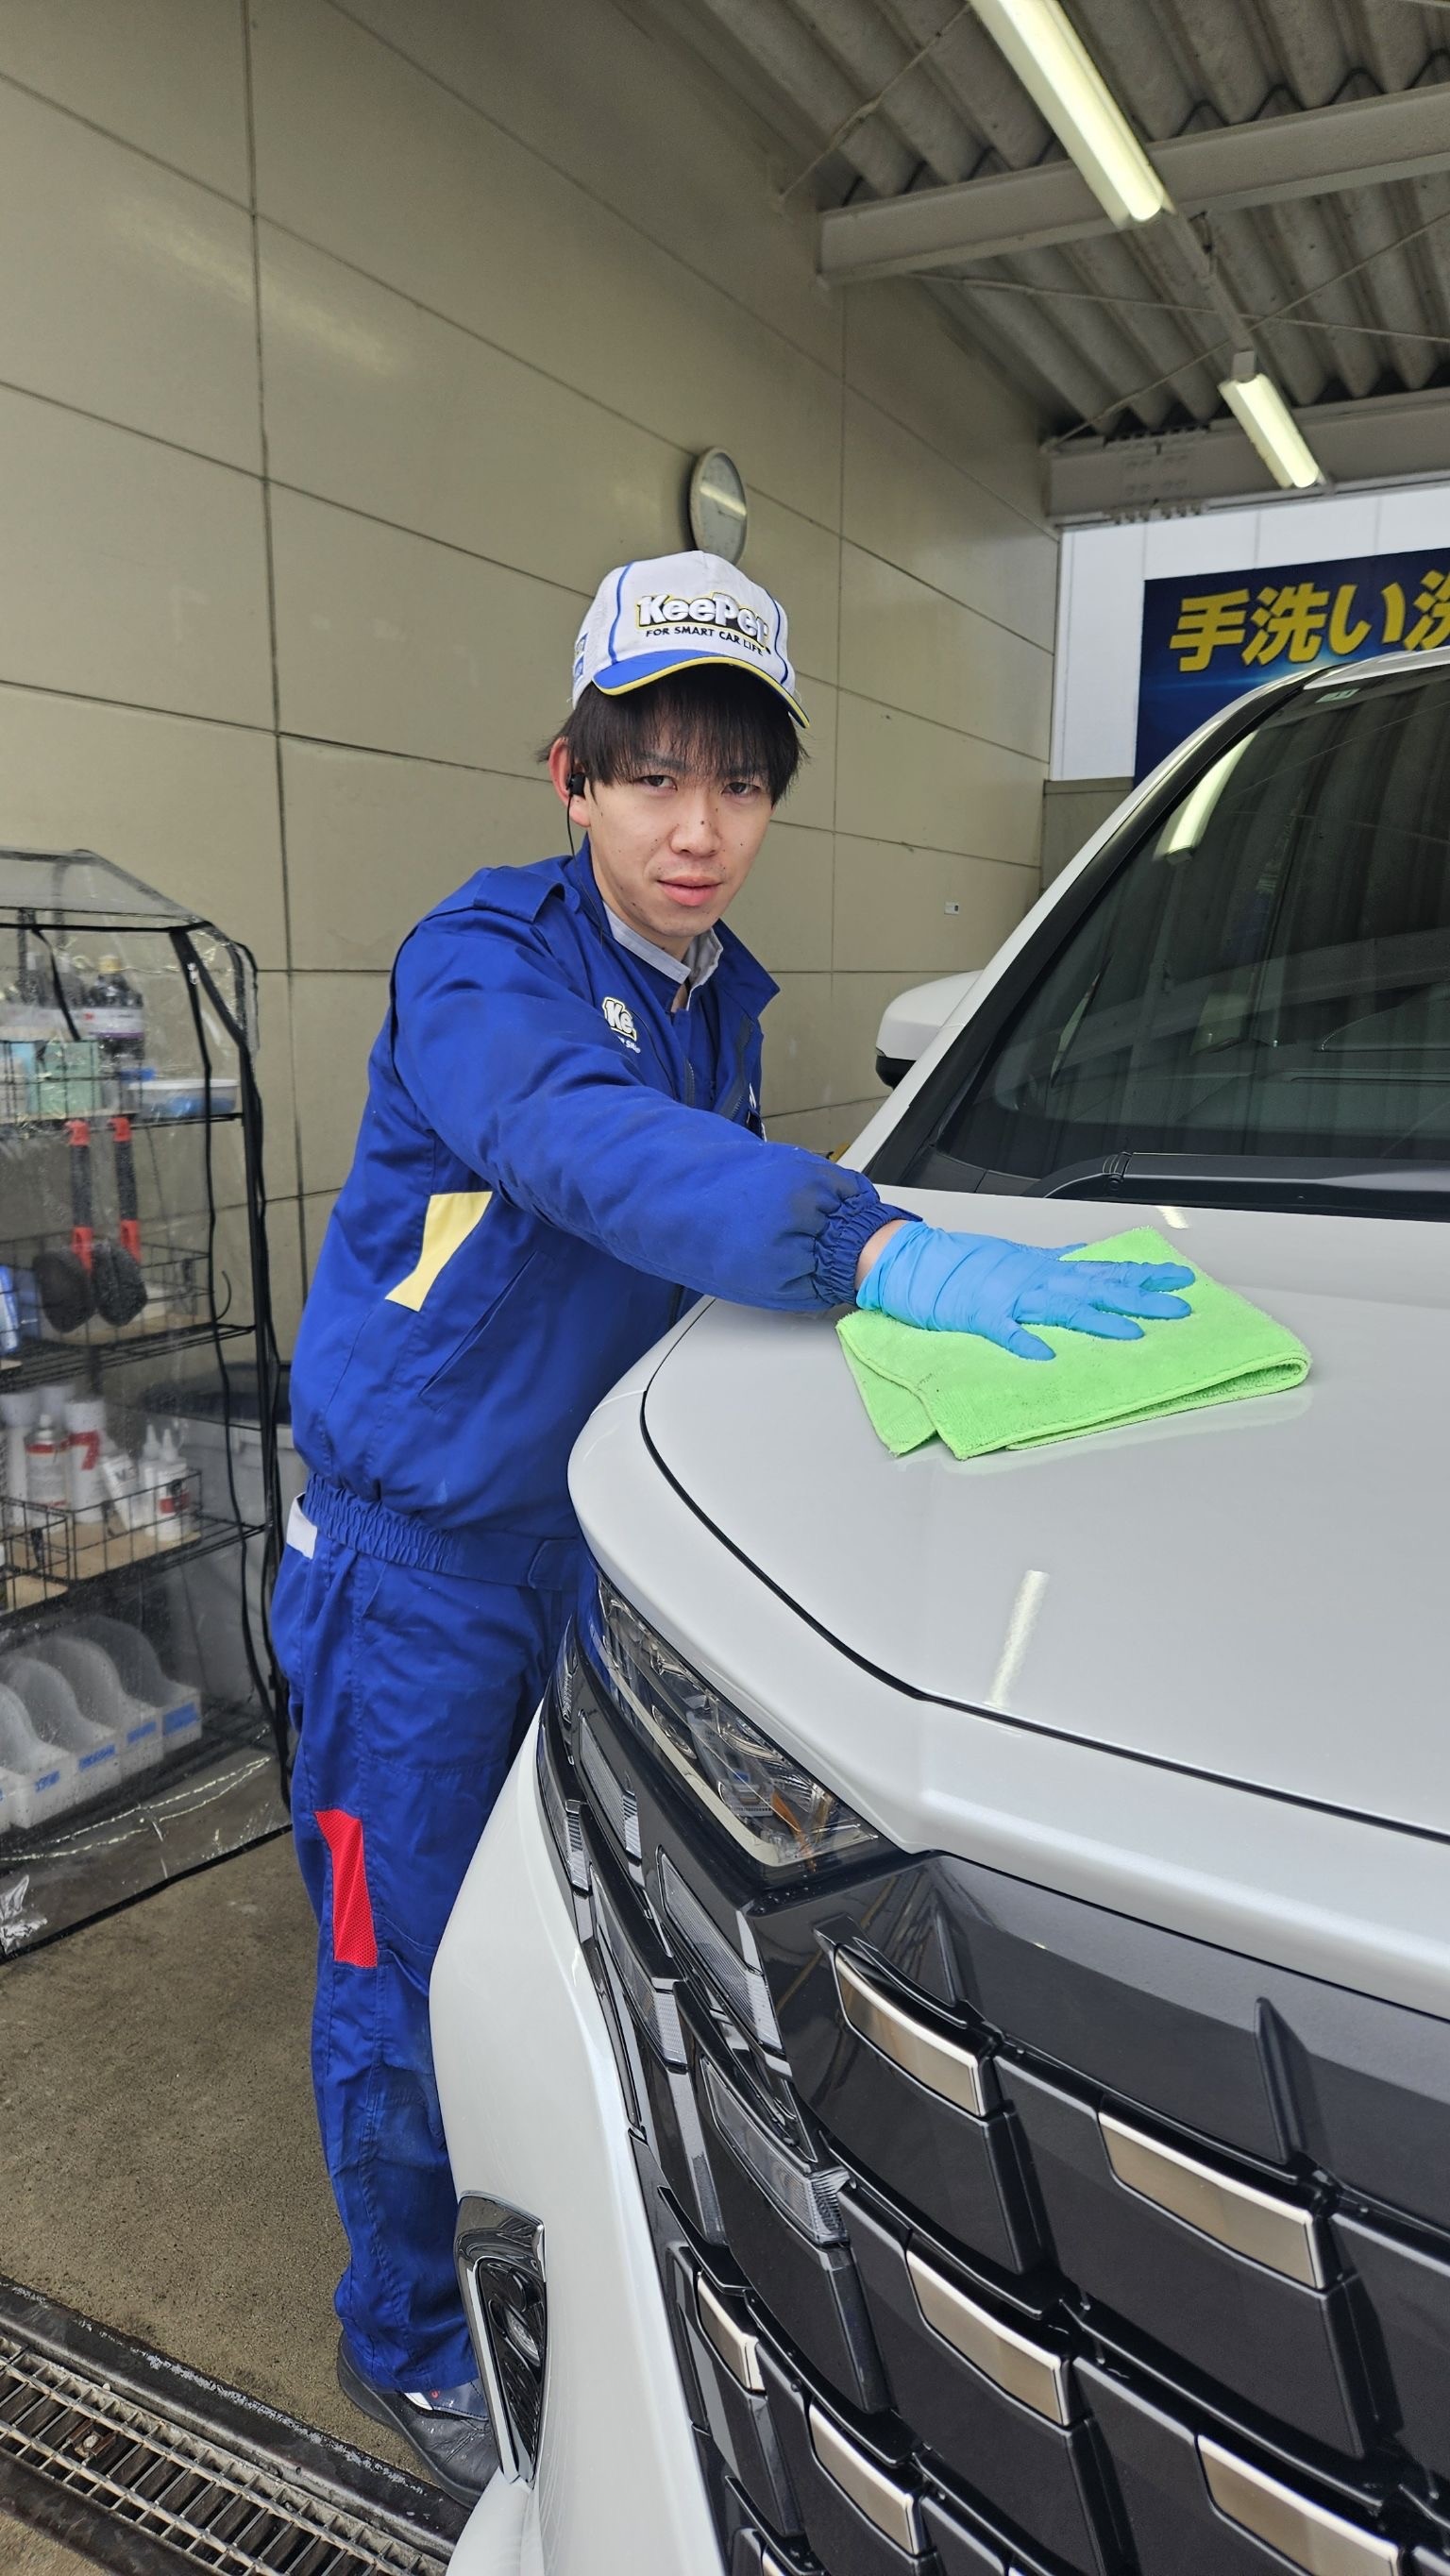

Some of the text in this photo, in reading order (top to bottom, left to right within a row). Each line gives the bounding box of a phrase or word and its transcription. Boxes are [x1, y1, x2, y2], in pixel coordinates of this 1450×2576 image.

[636, 591, 769, 649] KeePer
[646, 627, 670, 637] FOR
[674, 625, 715, 636] SMART
[718, 631, 741, 645] CAR
